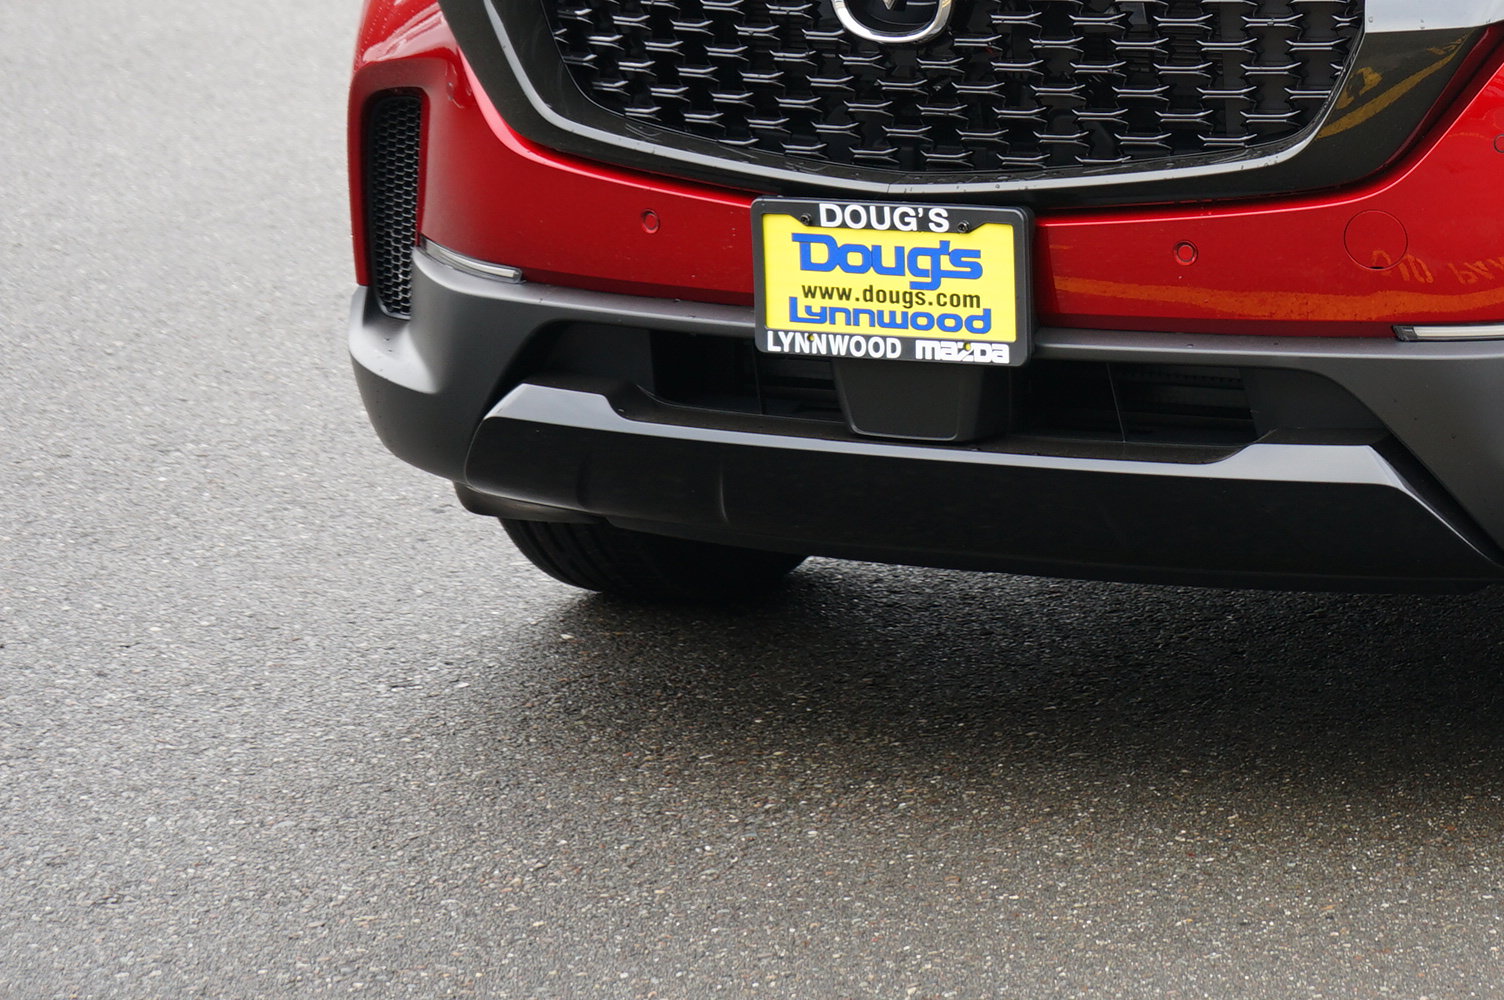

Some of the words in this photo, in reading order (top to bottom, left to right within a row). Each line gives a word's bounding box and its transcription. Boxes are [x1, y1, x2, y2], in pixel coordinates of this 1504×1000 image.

[819, 203, 950, 233] DOUG'S
[801, 284, 981, 309] www.dougs.com
[788, 296, 992, 335] Lynnwood
[767, 330, 902, 360] LYNNWOOD
